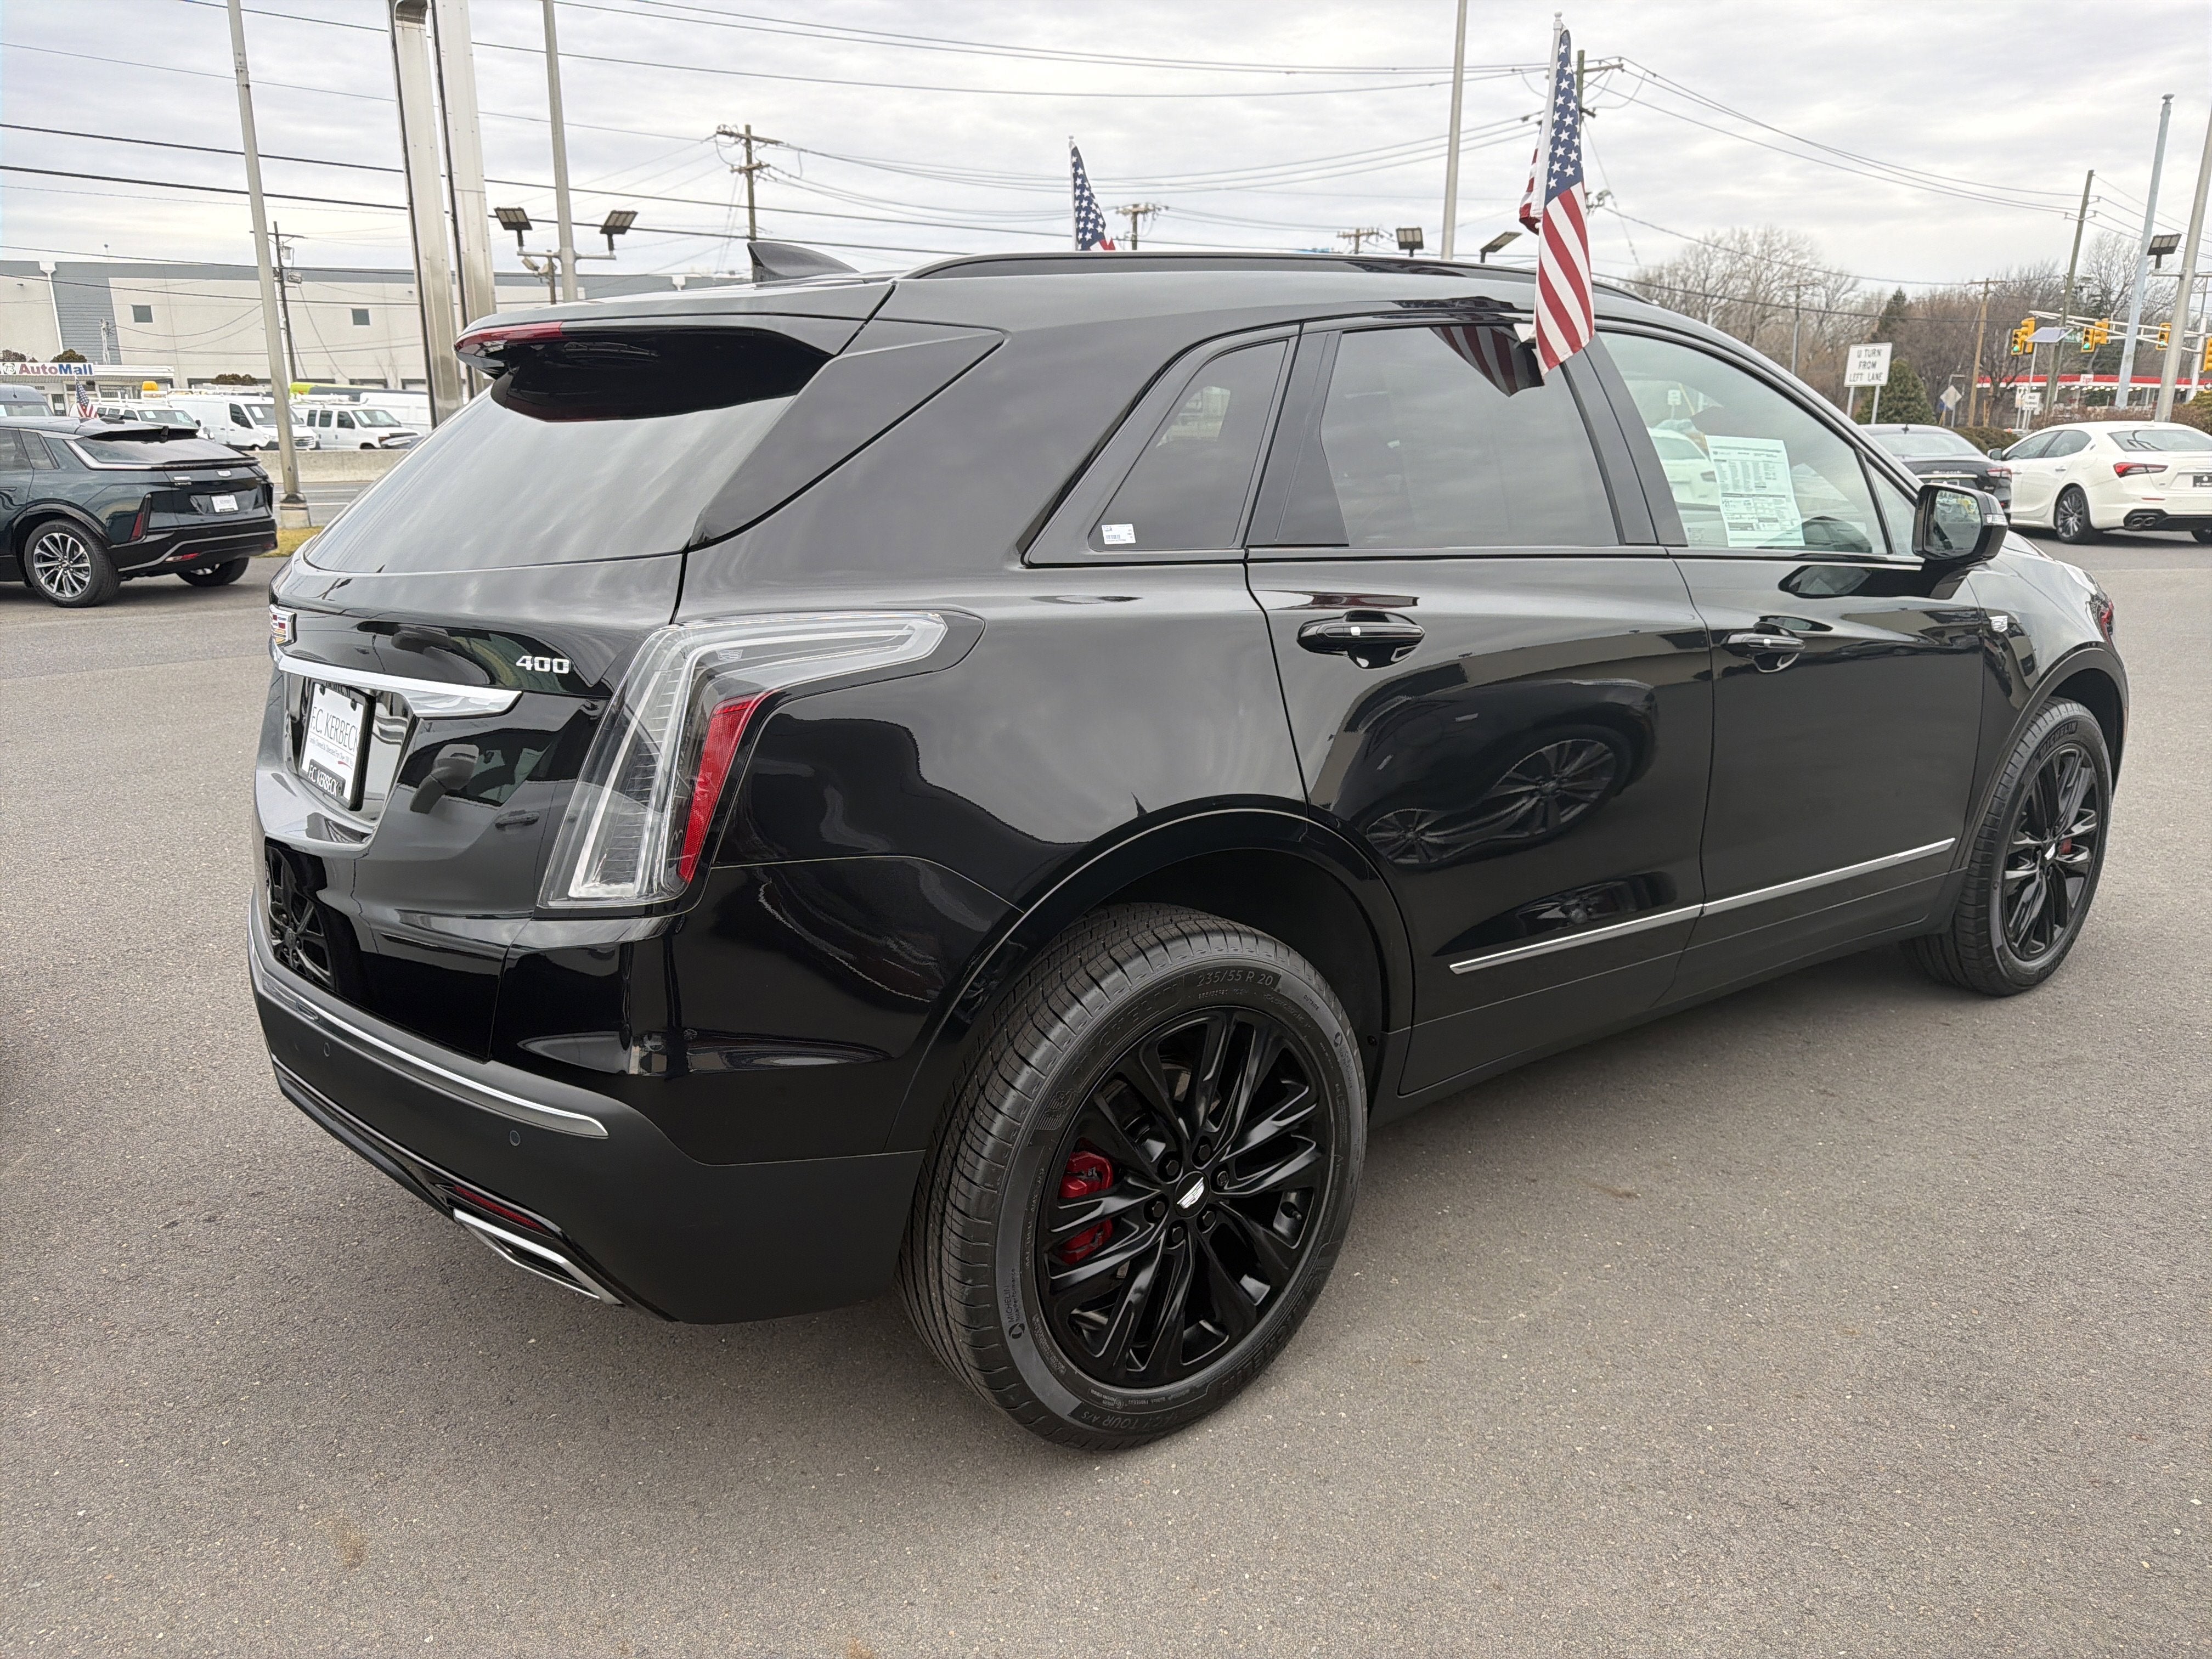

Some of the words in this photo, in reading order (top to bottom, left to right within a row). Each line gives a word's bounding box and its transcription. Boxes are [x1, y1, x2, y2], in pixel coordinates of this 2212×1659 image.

[1857, 349, 1862, 358] U
[1864, 348, 1882, 358] TURN
[18, 363, 93, 375] AutoMall
[1858, 360, 1876, 369] FROM
[1849, 373, 1864, 382] LEFT
[1867, 372, 1883, 382] LANE
[516, 656, 570, 674] 400
[310, 706, 324, 734] F.C.
[324, 713, 359, 752] KERBECK
[316, 770, 338, 797] KERBECK
[1197, 969, 1244, 987] 235/55
[1245, 970, 1255, 983] R
[1257, 973, 1273, 986] 20
[1303, 994, 1319, 1011] OUTSIDE
[1003, 1285, 1014, 1323] MICHELIN
[1081, 1411, 1101, 1423] A/S
[1102, 1415, 1139, 1429] TOUR
